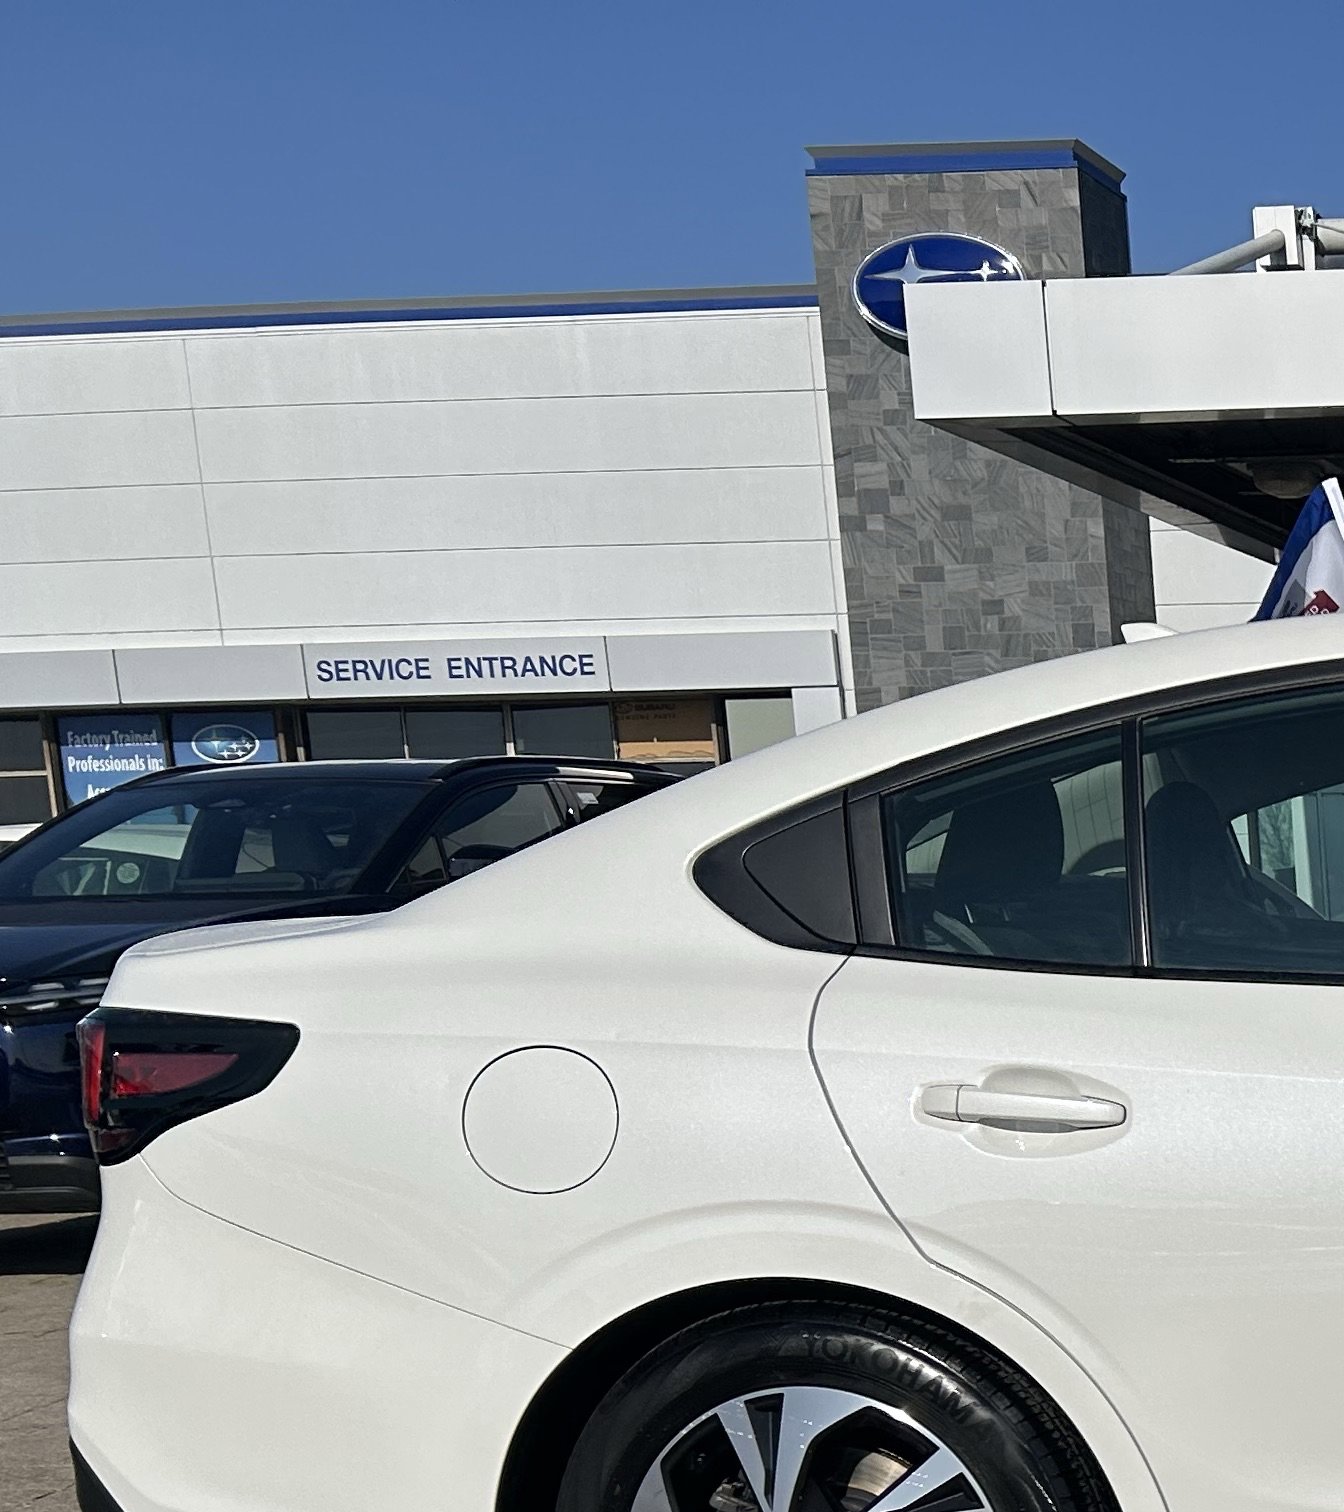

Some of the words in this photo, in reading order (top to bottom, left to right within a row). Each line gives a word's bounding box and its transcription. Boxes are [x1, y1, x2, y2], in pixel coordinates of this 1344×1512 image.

[316, 657, 431, 682] SERVICE
[447, 654, 596, 679] ENTRANCE
[67, 730, 111, 751] Factory
[112, 729, 158, 746] Trained
[67, 754, 145, 773] Professionals
[147, 756, 164, 771] in:
[800, 1333, 998, 1438] YOKOHAMA
